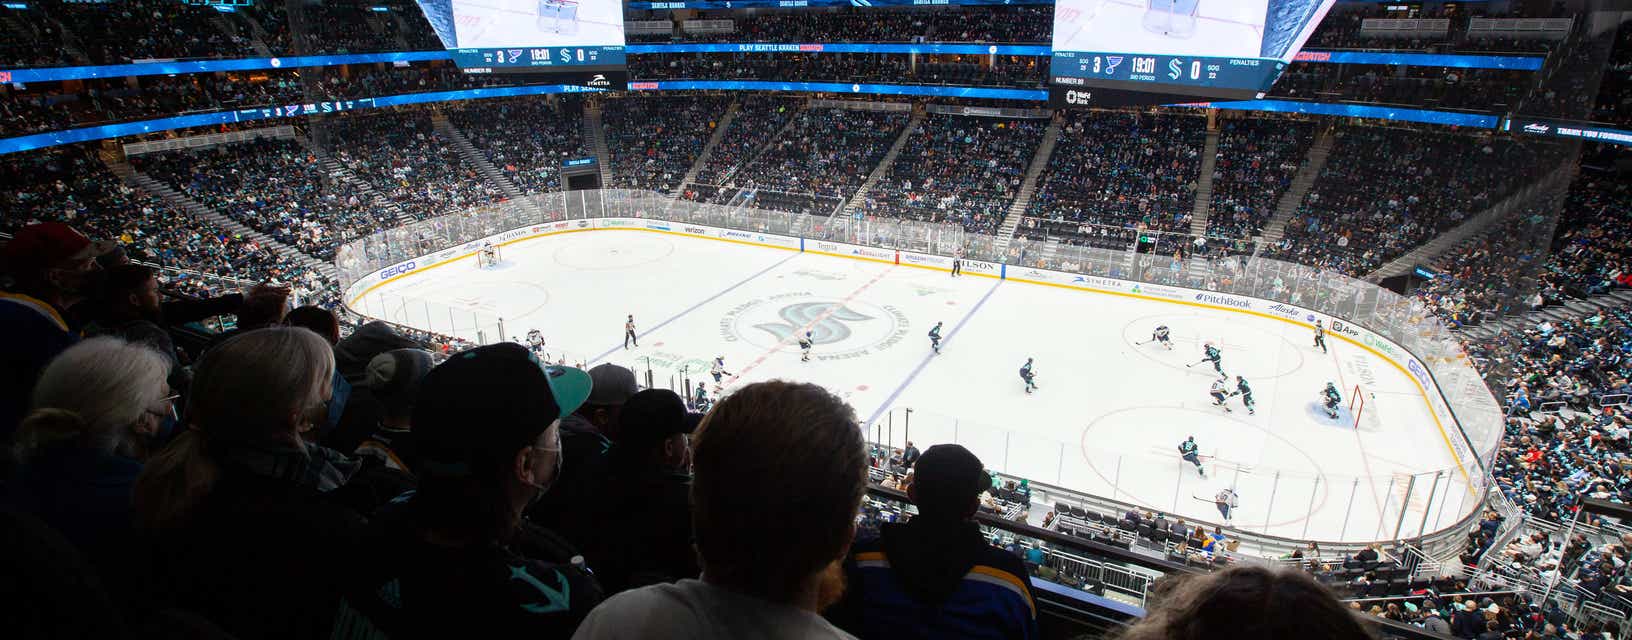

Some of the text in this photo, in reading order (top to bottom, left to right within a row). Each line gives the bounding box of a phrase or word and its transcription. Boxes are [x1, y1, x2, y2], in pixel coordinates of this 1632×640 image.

[740, 44, 753, 52] PLAY
[755, 44, 777, 52] SEATTLE
[496, 50, 504, 63] 3
[531, 49, 550, 60] 19:01
[577, 49, 584, 61] 0
[1093, 56, 1101, 73] 3
[1132, 57, 1155, 74] 19:01
[1229, 58, 1260, 66] PENALTIES
[1190, 61, 1200, 80] 0
[1557, 127, 1582, 136] THANK
[1582, 130, 1598, 138] YOU
[685, 226, 705, 236] verizon
[380, 261, 416, 280] GEICO
[962, 260, 994, 270] ILSON
[1087, 277, 1121, 287] SYMETRA
[1204, 294, 1251, 309] PitchBook
[1268, 303, 1300, 316] Alaska
[1342, 326, 1359, 336] App
[1408, 358, 1431, 391] GEICO
